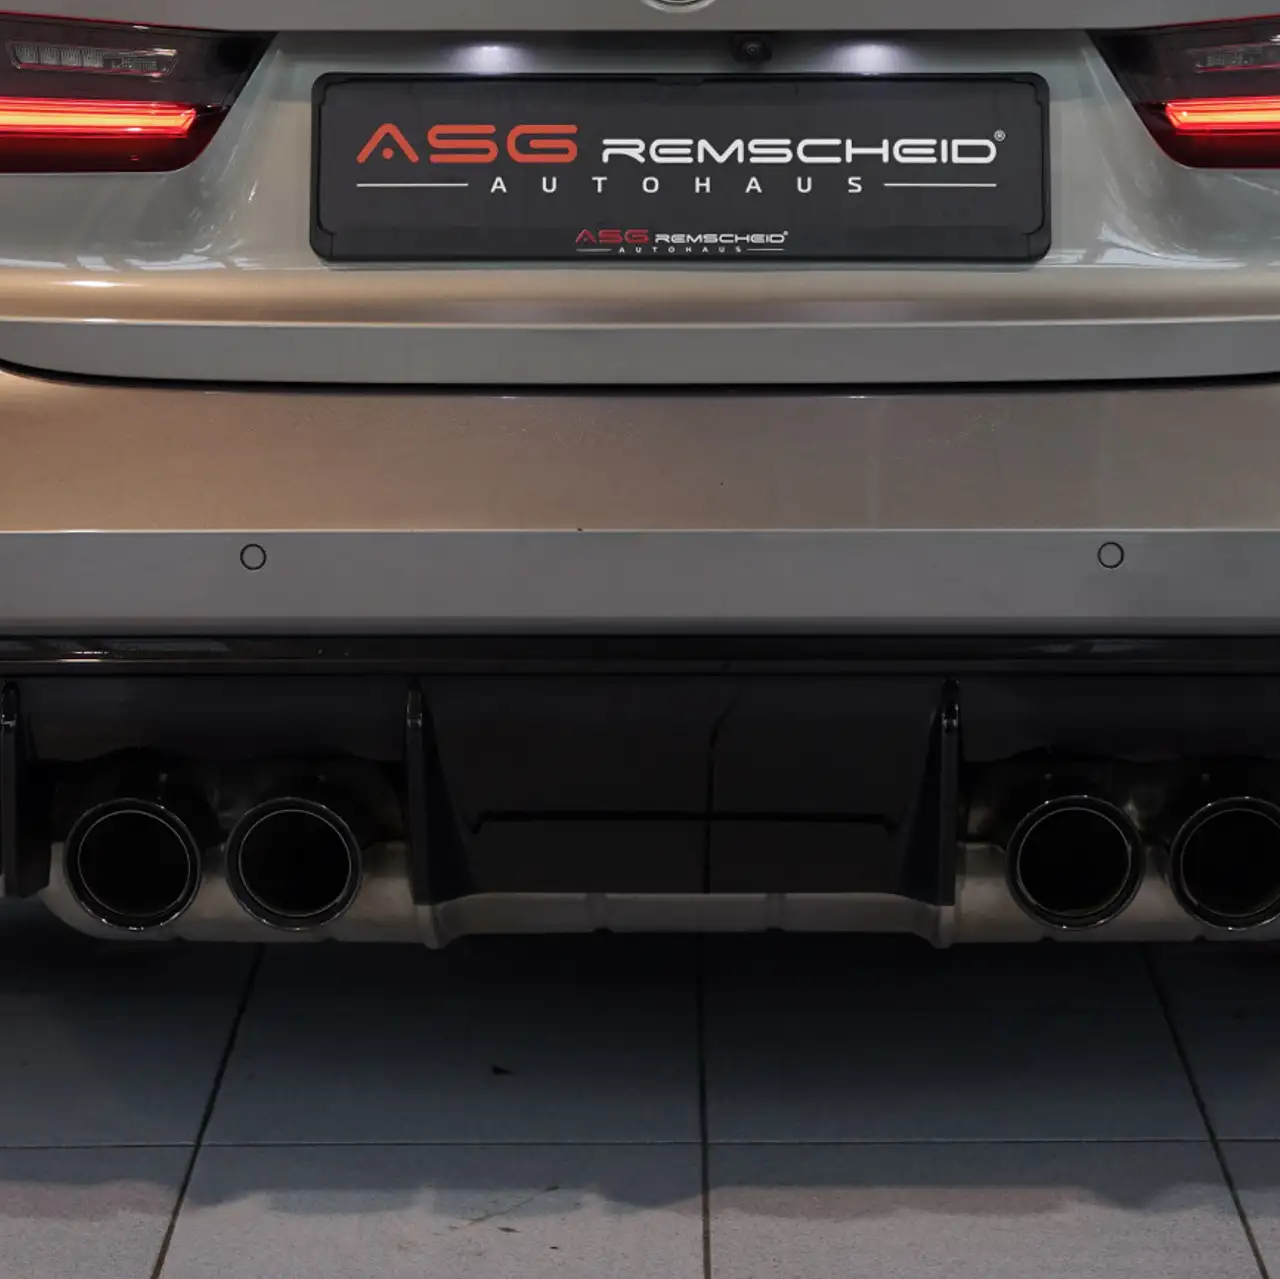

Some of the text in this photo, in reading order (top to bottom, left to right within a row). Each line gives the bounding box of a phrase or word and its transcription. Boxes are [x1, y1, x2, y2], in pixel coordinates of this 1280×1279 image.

[356, 123, 578, 163] ASG
[490, 176, 863, 193] AUTOHAUS
[575, 228, 649, 244] ASG
